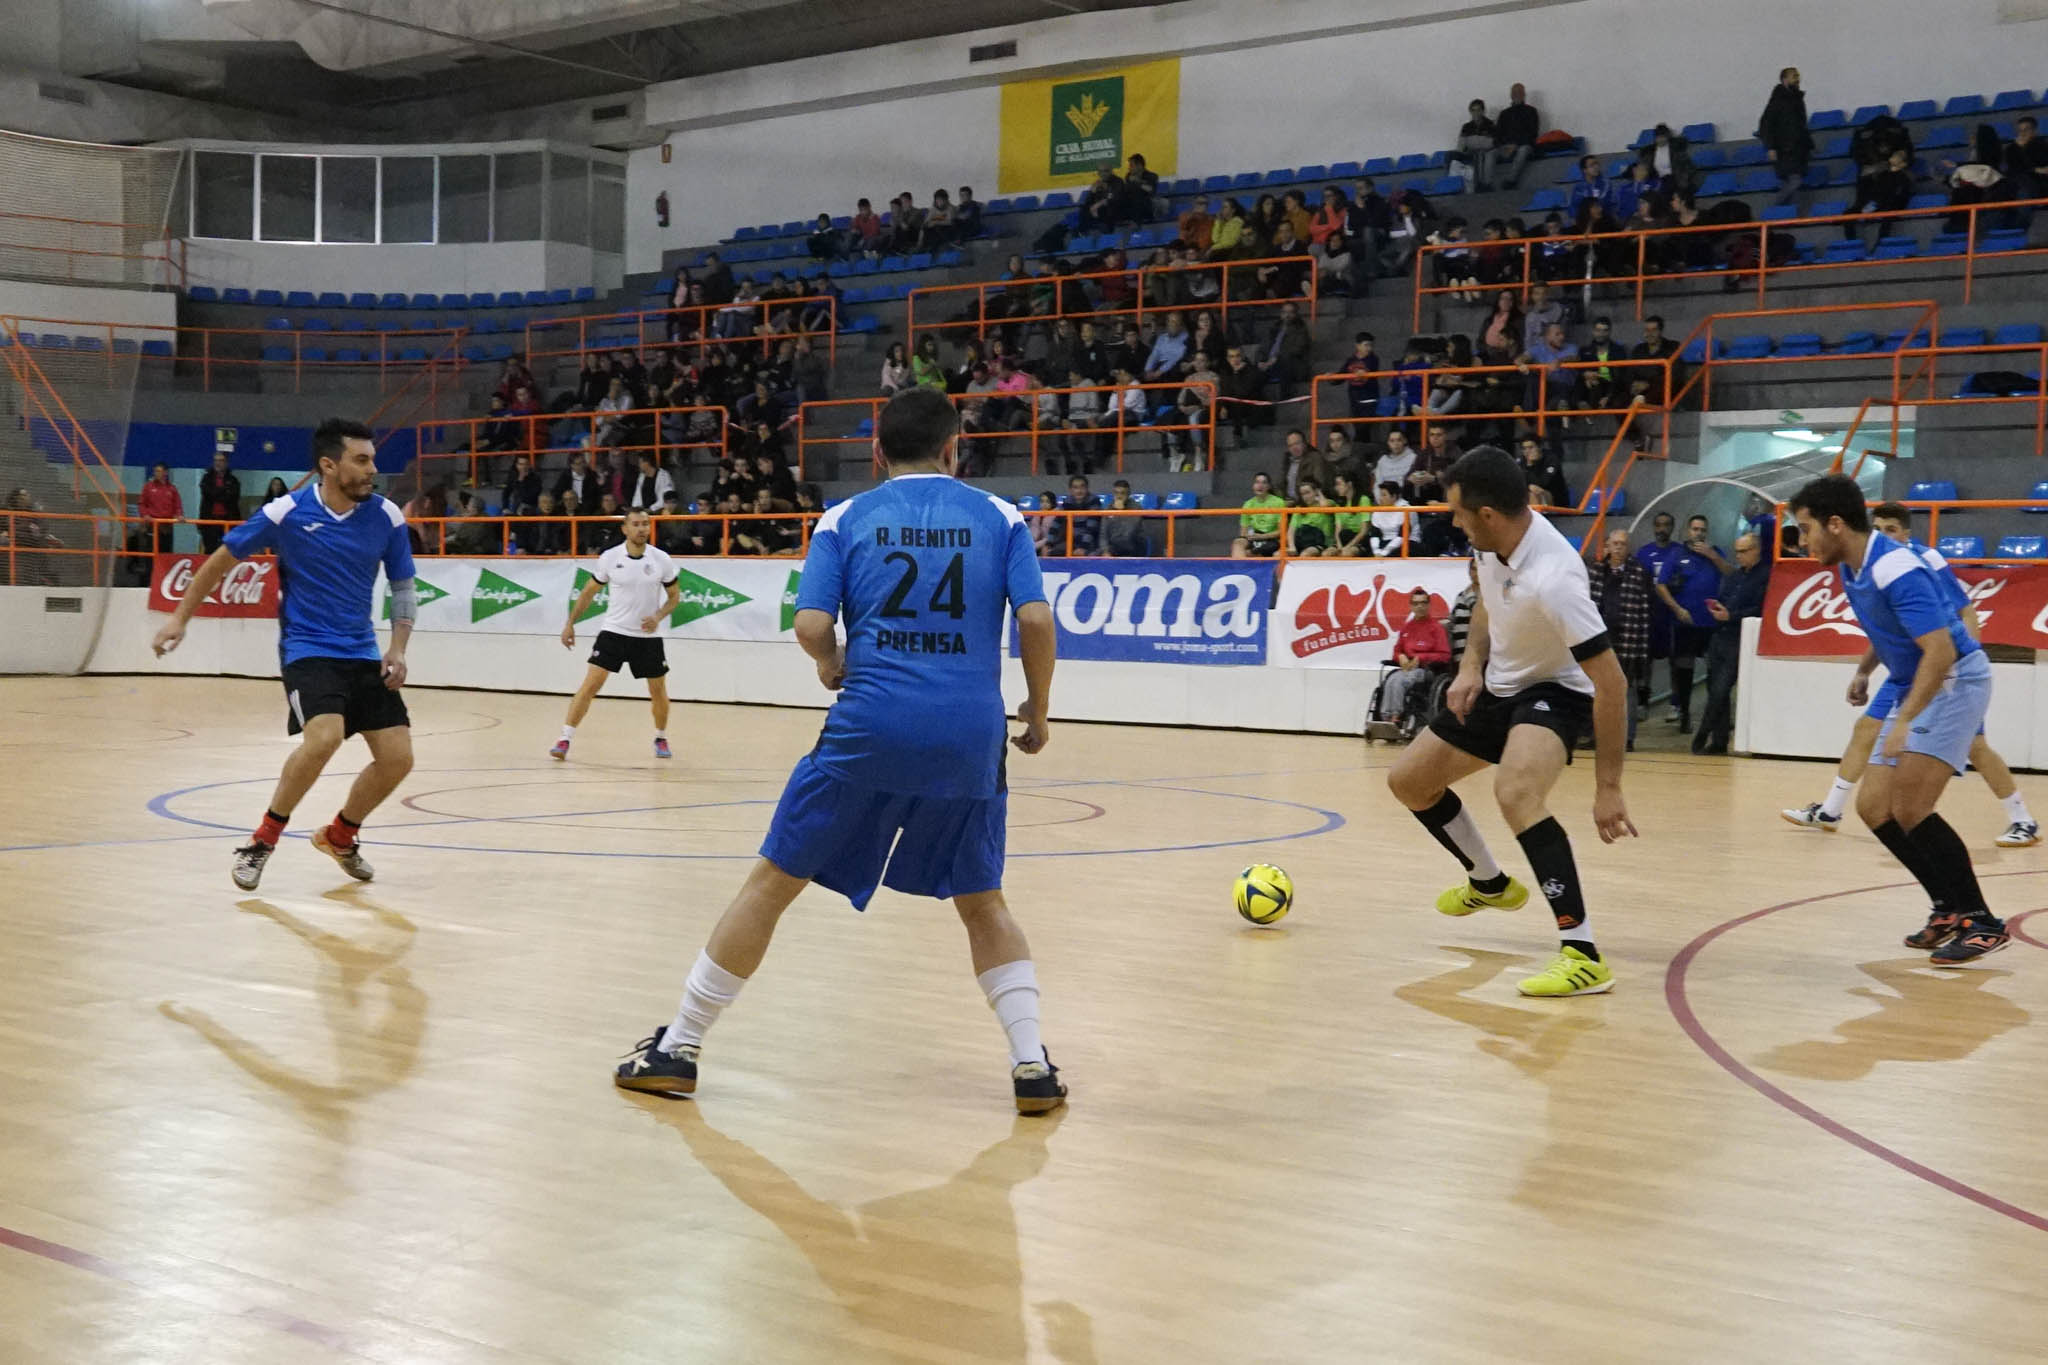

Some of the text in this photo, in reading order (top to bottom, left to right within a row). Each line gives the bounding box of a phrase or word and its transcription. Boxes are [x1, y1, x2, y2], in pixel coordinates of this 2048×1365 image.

[876, 527, 972, 548] R. BENITO
[879, 551, 966, 619] 24
[876, 630, 967, 655] PRENSA
[1303, 625, 1380, 652] fundación
